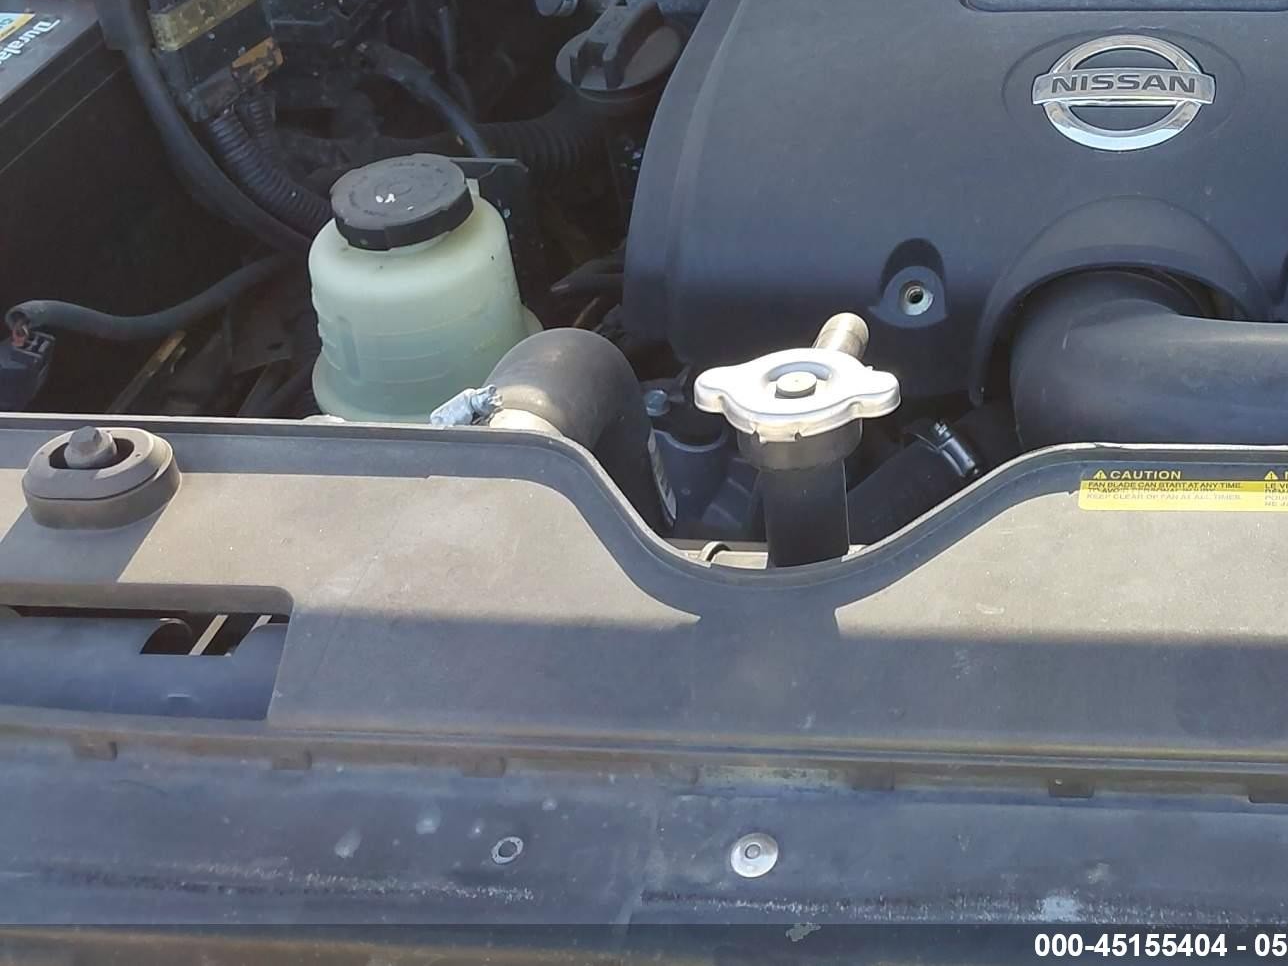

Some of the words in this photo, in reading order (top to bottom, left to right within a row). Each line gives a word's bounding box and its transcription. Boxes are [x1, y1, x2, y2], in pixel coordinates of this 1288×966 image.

[0, 19, 61, 65] Durala
[1051, 74, 1196, 94] NISSAN
[1110, 470, 1182, 480] CAUTION
